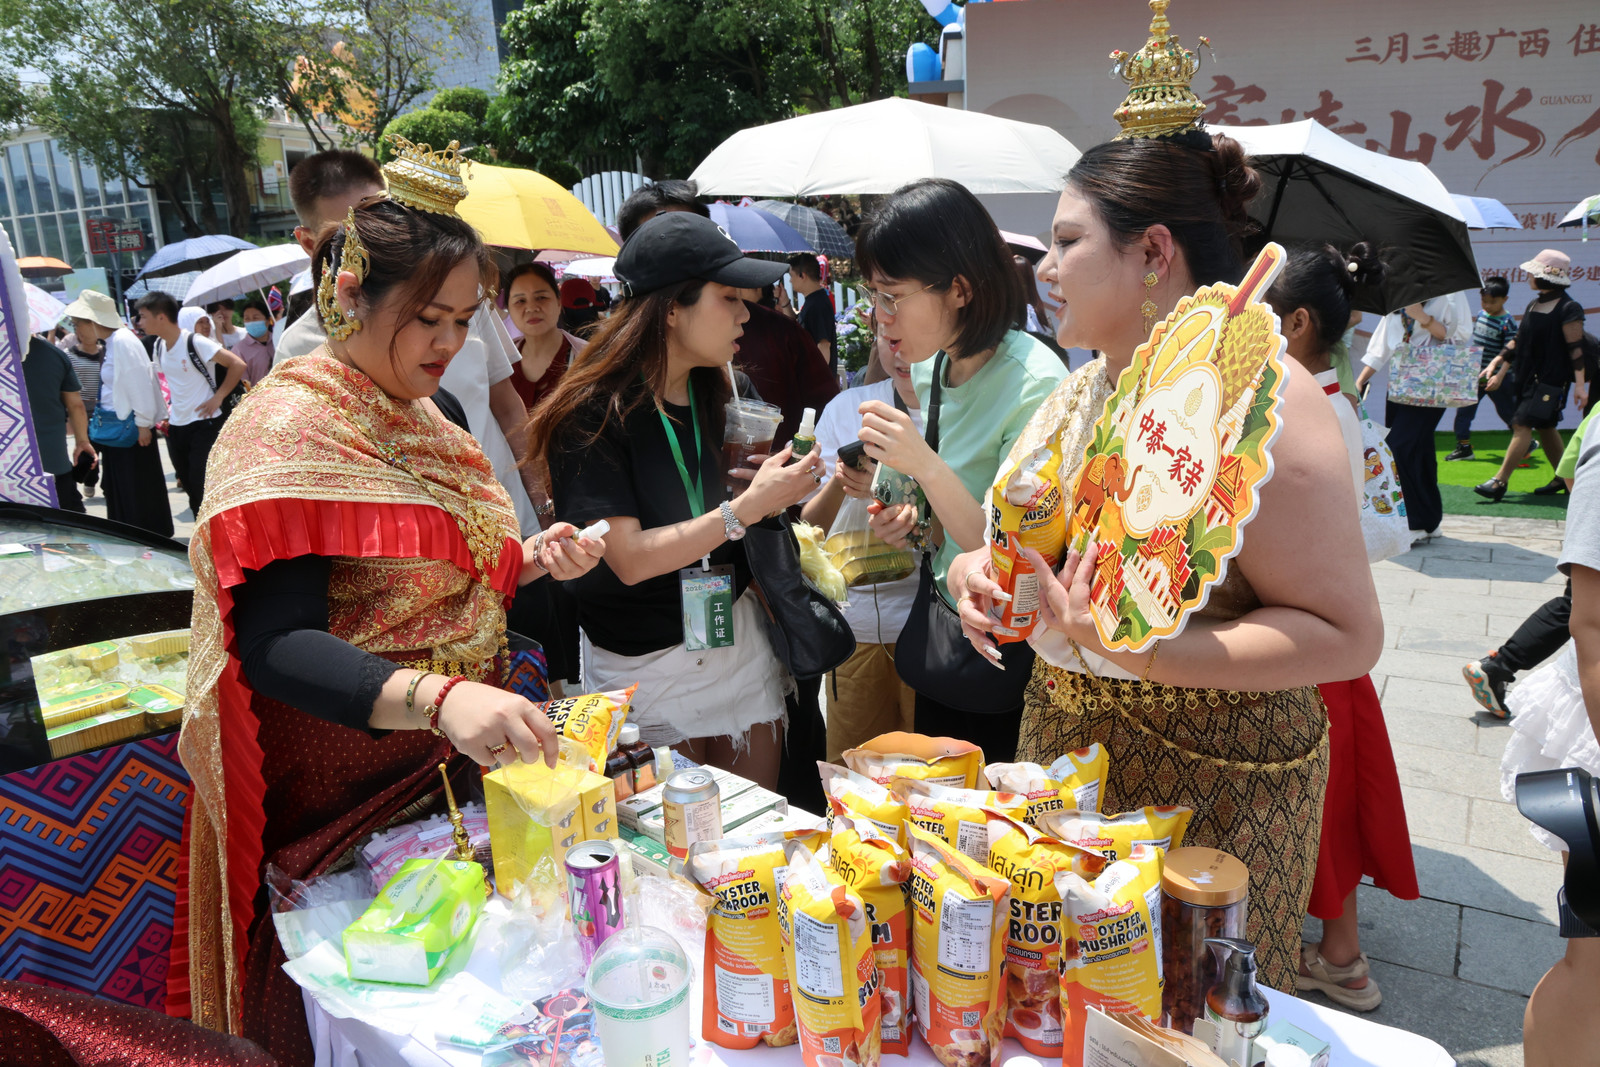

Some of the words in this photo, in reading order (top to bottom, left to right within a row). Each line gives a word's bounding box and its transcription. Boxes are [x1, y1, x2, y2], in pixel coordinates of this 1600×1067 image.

[1345, 28, 1550, 64] 三月三趣广西
[1539, 94, 1593, 106] GUANGXI
[1136, 408, 1206, 497] 中泰一家亲
[713, 602, 726, 638] 工作证
[1078, 921, 1148, 953] MUSHROOM
[1097, 911, 1142, 937] OYSTER
